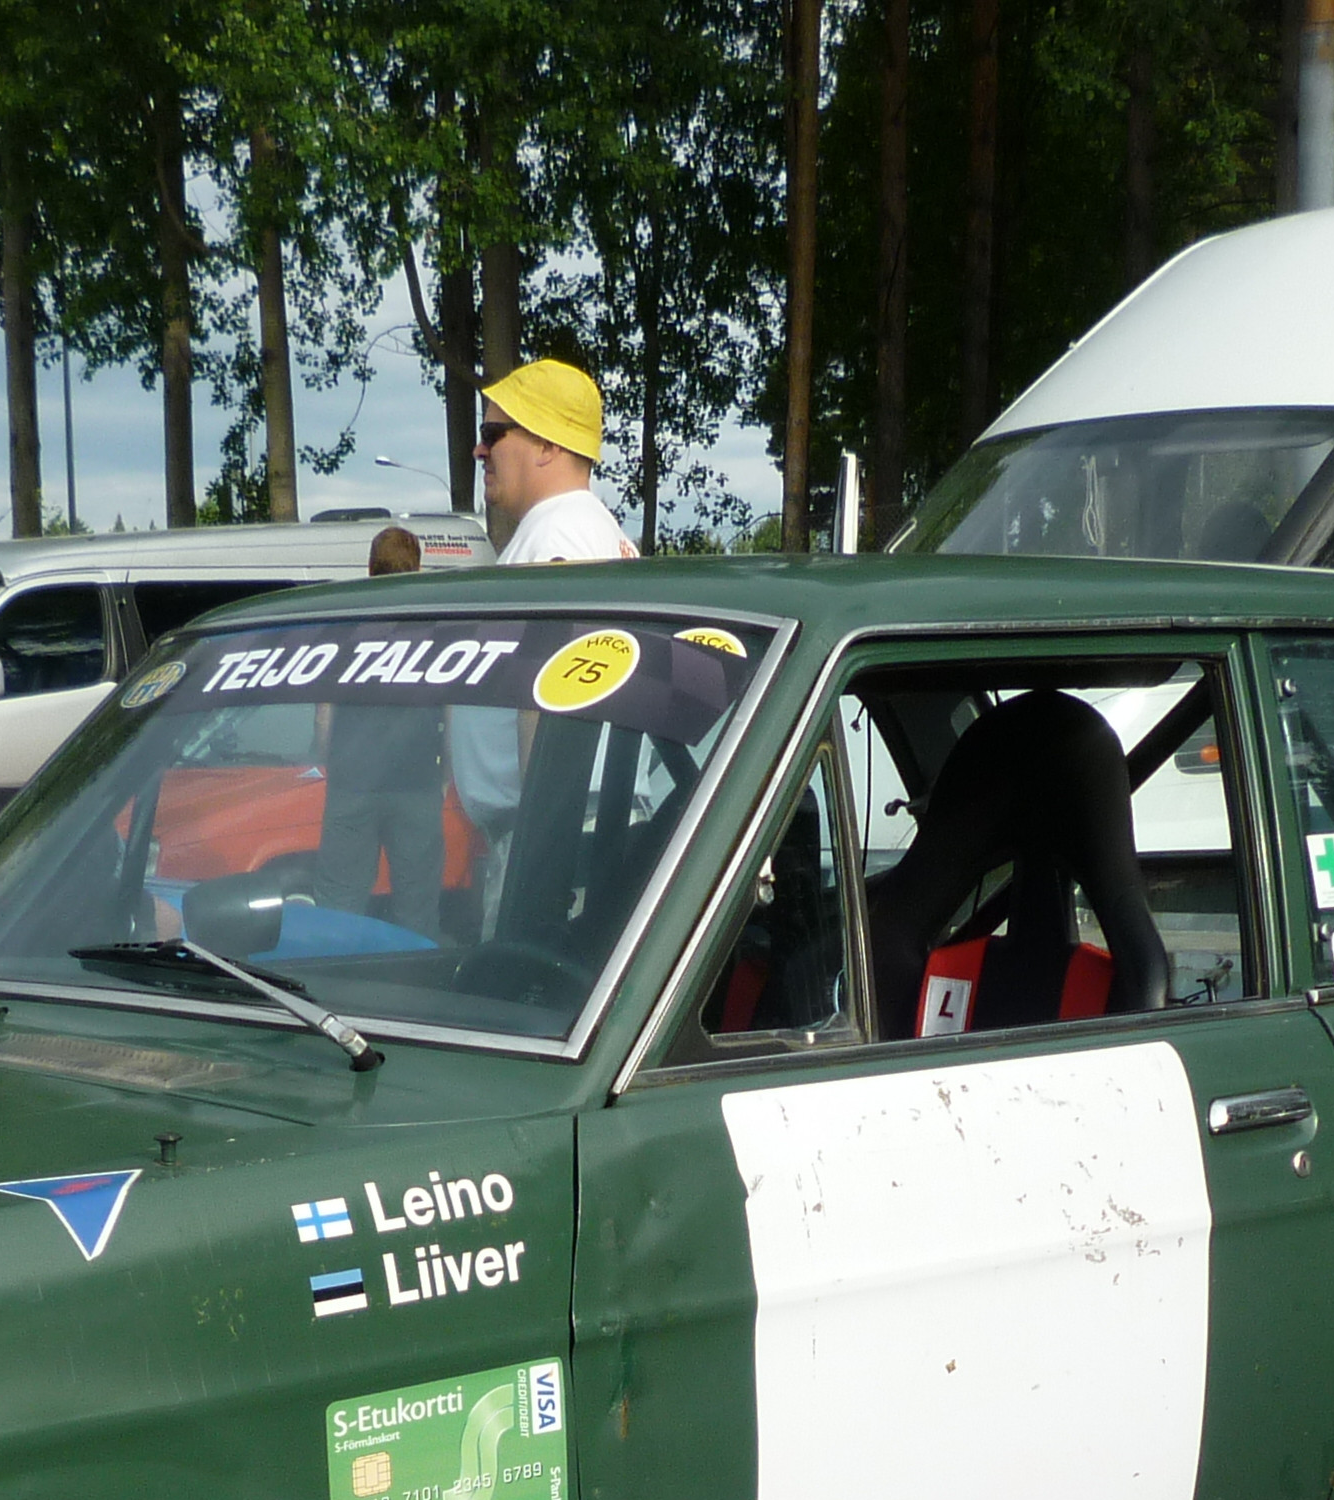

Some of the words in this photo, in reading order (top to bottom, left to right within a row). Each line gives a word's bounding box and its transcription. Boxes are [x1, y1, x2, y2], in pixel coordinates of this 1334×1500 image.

[202, 643, 340, 693] TEIJO
[337, 639, 519, 685] TALOT
[562, 657, 609, 684] 75
[587, 636, 630, 655] HRCF
[364, 1170, 514, 1233] Leino
[382, 1241, 526, 1305] Liiver
[333, 1385, 464, 1438] S-Etukortti
[517, 1369, 529, 1438] CREDIT/DEBIT
[537, 1370, 556, 1430] VISA
[334, 1430, 401, 1454] S-Förmånskort
[452, 1473, 493, 1495] 2345
[502, 1461, 543, 1484] 6789
